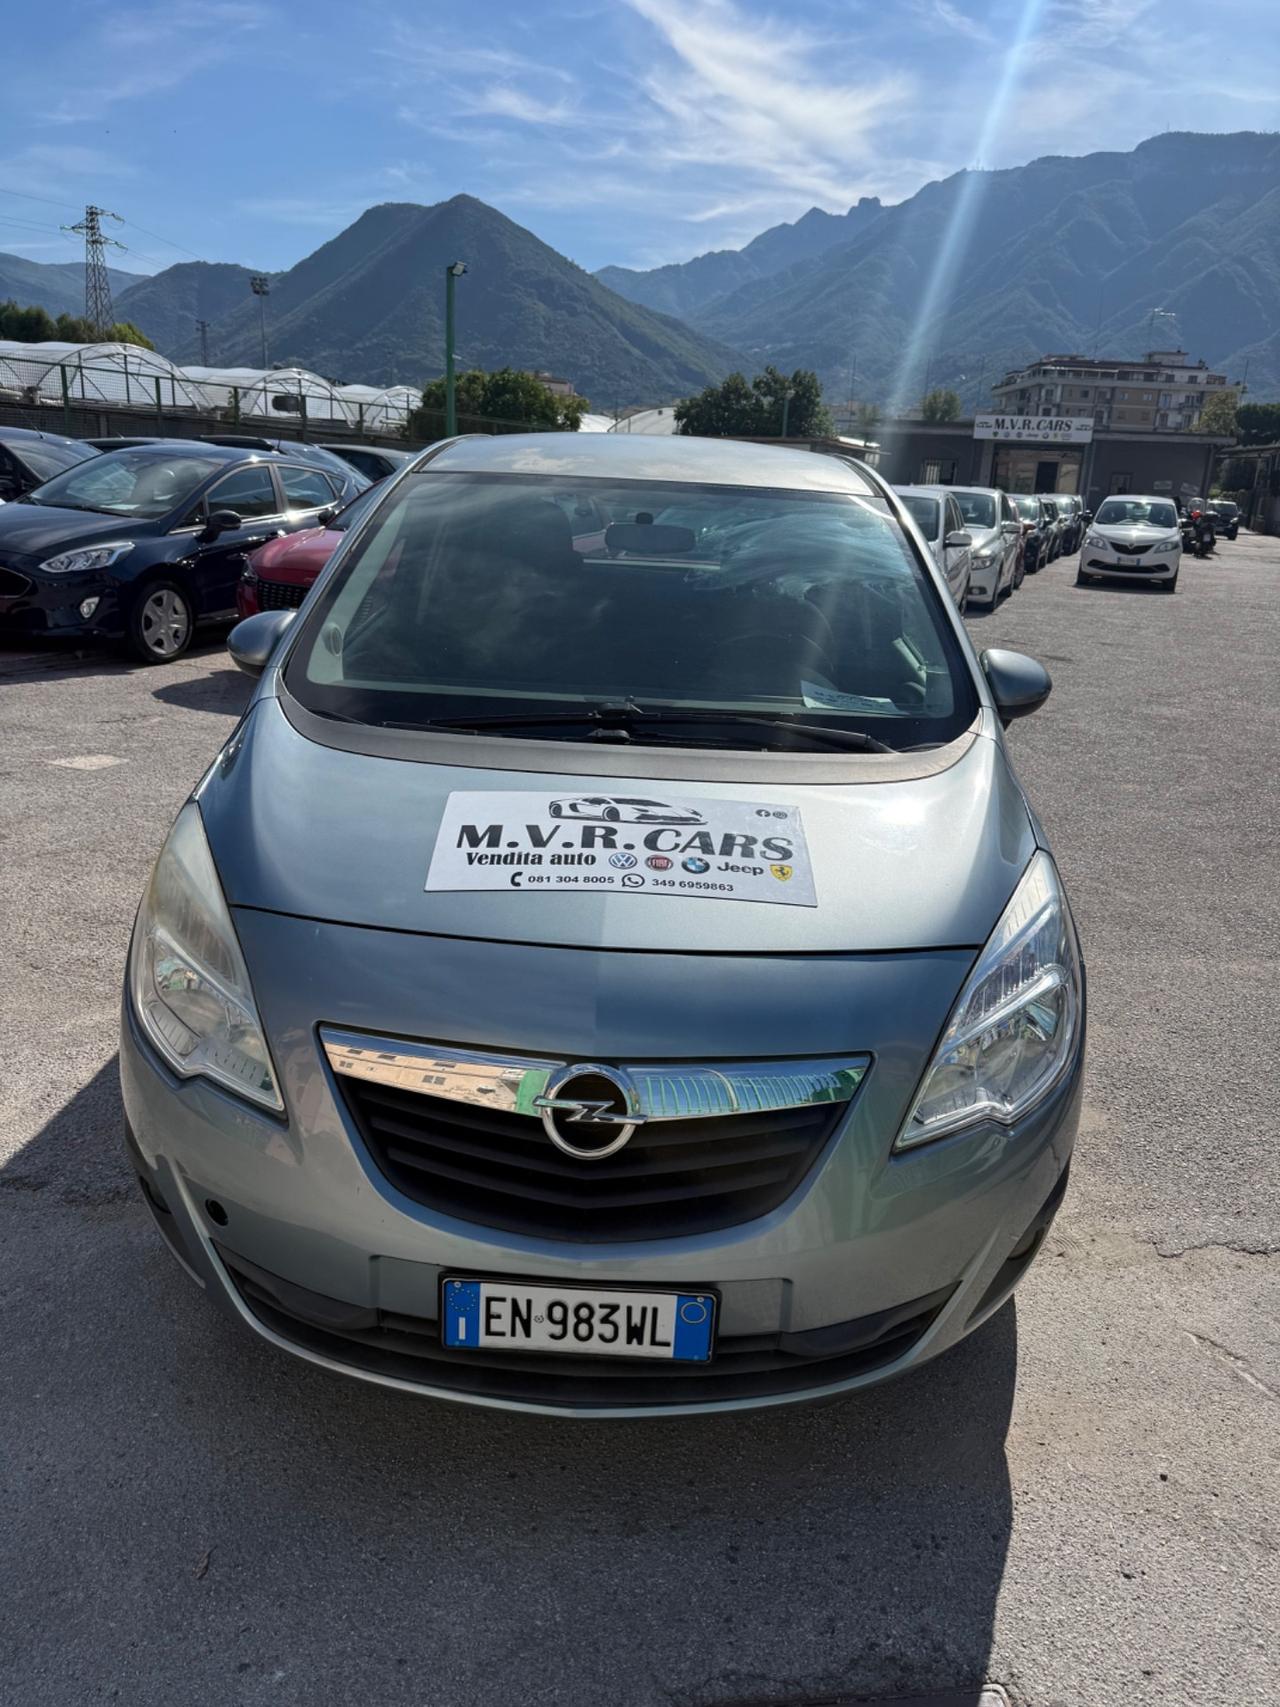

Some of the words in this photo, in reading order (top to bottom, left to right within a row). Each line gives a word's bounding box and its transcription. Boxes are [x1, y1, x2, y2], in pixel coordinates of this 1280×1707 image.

[466, 852, 543, 866] Vendita
[550, 853, 597, 866] auto
[717, 862, 765, 876] Jeep
[528, 875, 551, 883] 081
[556, 875, 579, 883] 304
[583, 876, 615, 884] 8005
[652, 878, 676, 888] 349
[679, 880, 734, 892] 6959863
[485, 1297, 532, 1338] EN
[547, 1300, 671, 1347] 983WL
